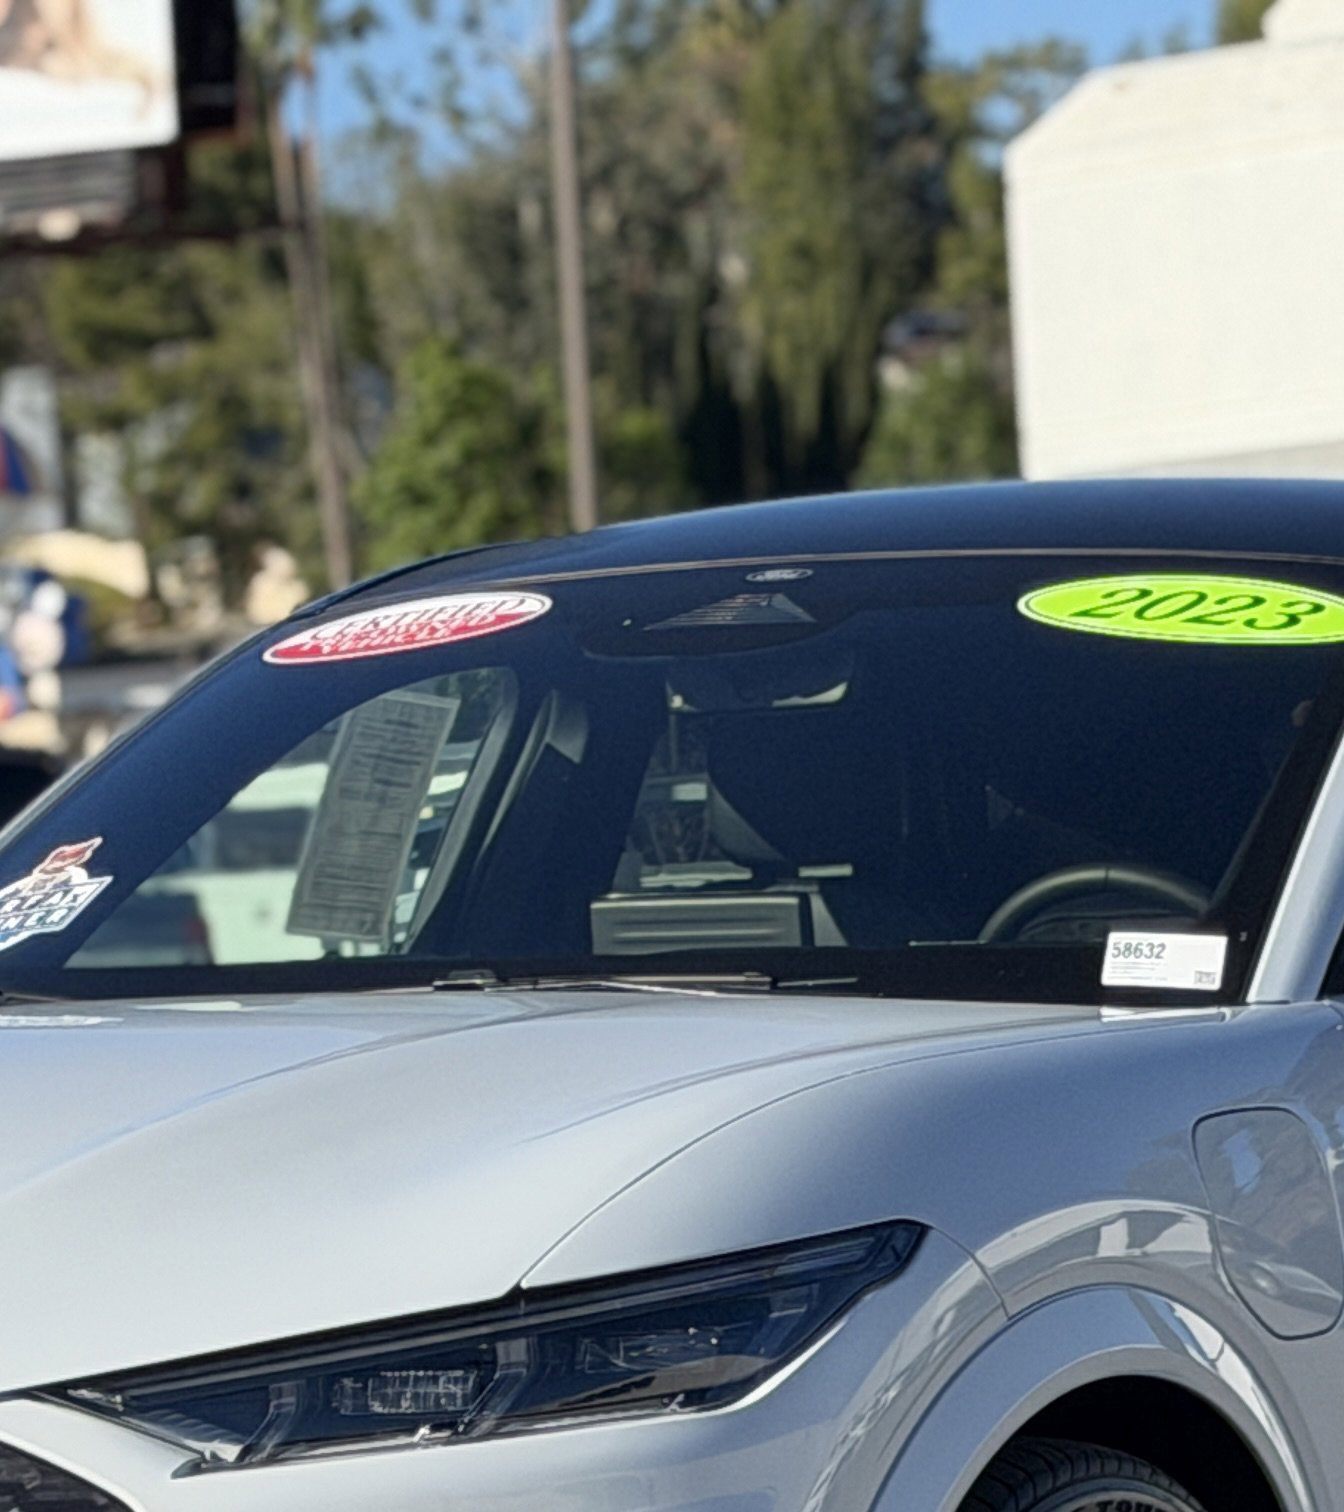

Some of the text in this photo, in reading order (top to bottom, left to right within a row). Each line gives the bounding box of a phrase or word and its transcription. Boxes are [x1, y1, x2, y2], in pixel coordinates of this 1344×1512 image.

[310, 598, 526, 641] CERTIFIED
[1069, 587, 1327, 630] 2023
[1111, 942, 1166, 960] 58632
